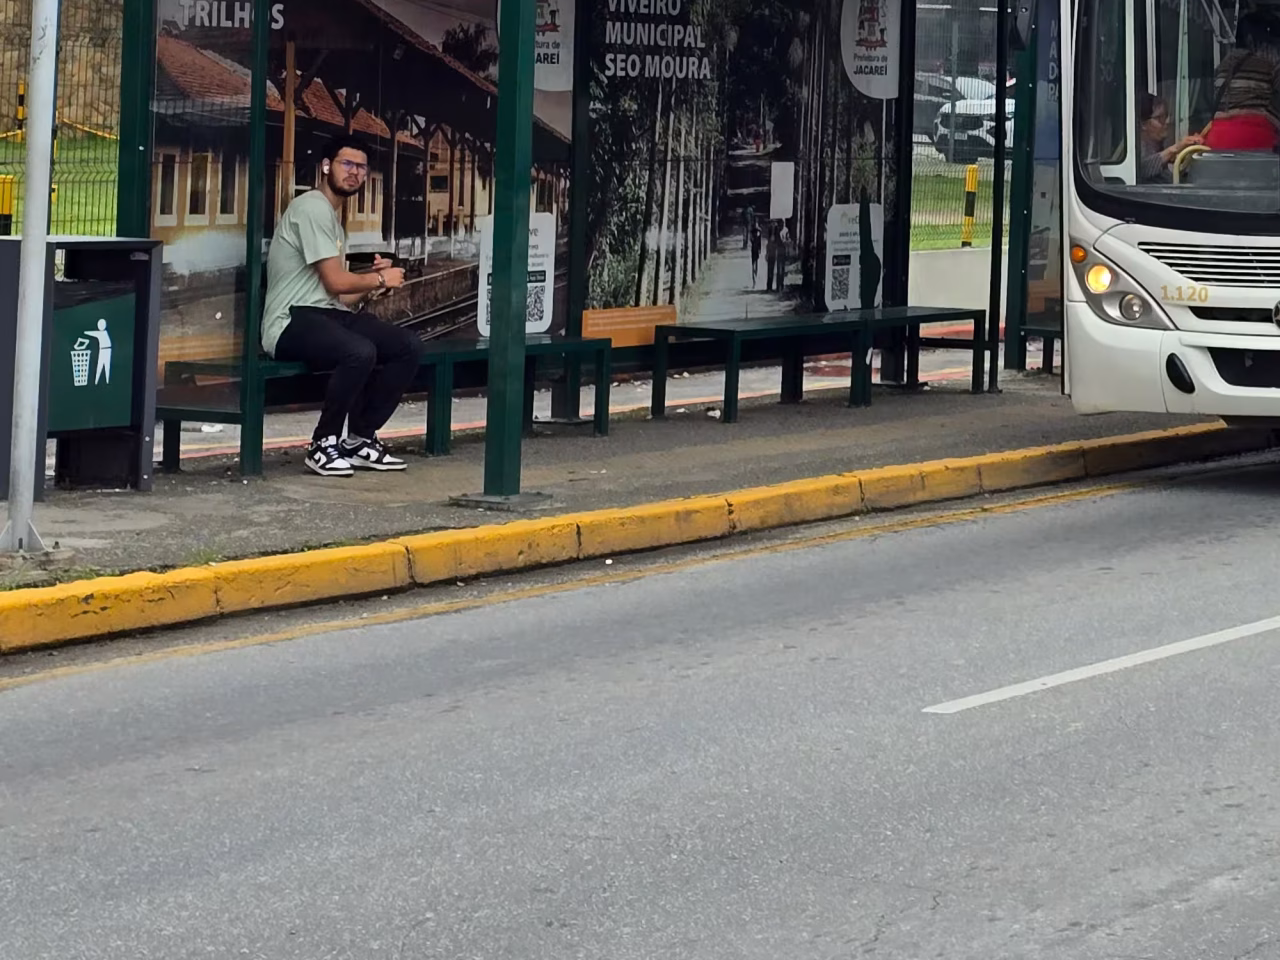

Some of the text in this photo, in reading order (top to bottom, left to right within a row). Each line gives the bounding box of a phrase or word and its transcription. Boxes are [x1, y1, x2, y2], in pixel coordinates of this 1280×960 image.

[179, 0, 285, 30] TRILHS
[605, 21, 706, 48] MUNICIPAL
[535, 51, 560, 65] AREÍ
[605, 53, 711, 79] SEO MOURA
[1160, 285, 1209, 303] 1.120
